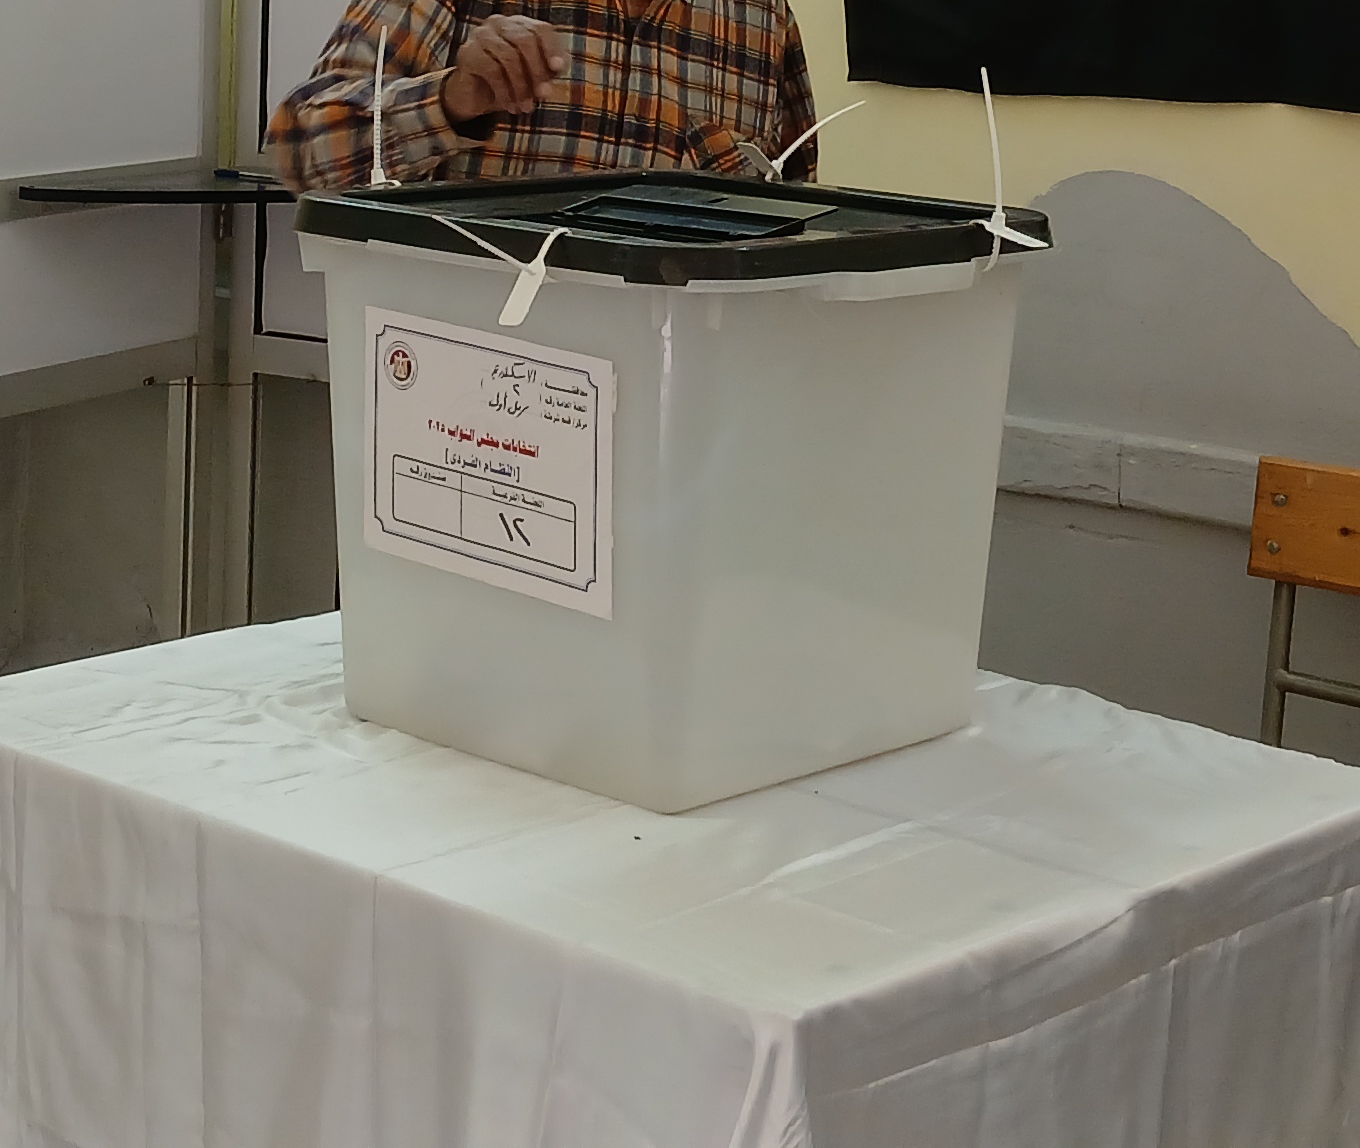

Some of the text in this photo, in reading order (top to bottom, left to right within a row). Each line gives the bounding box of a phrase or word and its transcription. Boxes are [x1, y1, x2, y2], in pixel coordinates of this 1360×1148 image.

[447, 424, 476, 443] النواب
[476, 432, 500, 452] مجلس
[501, 438, 539, 458] انتخابات
